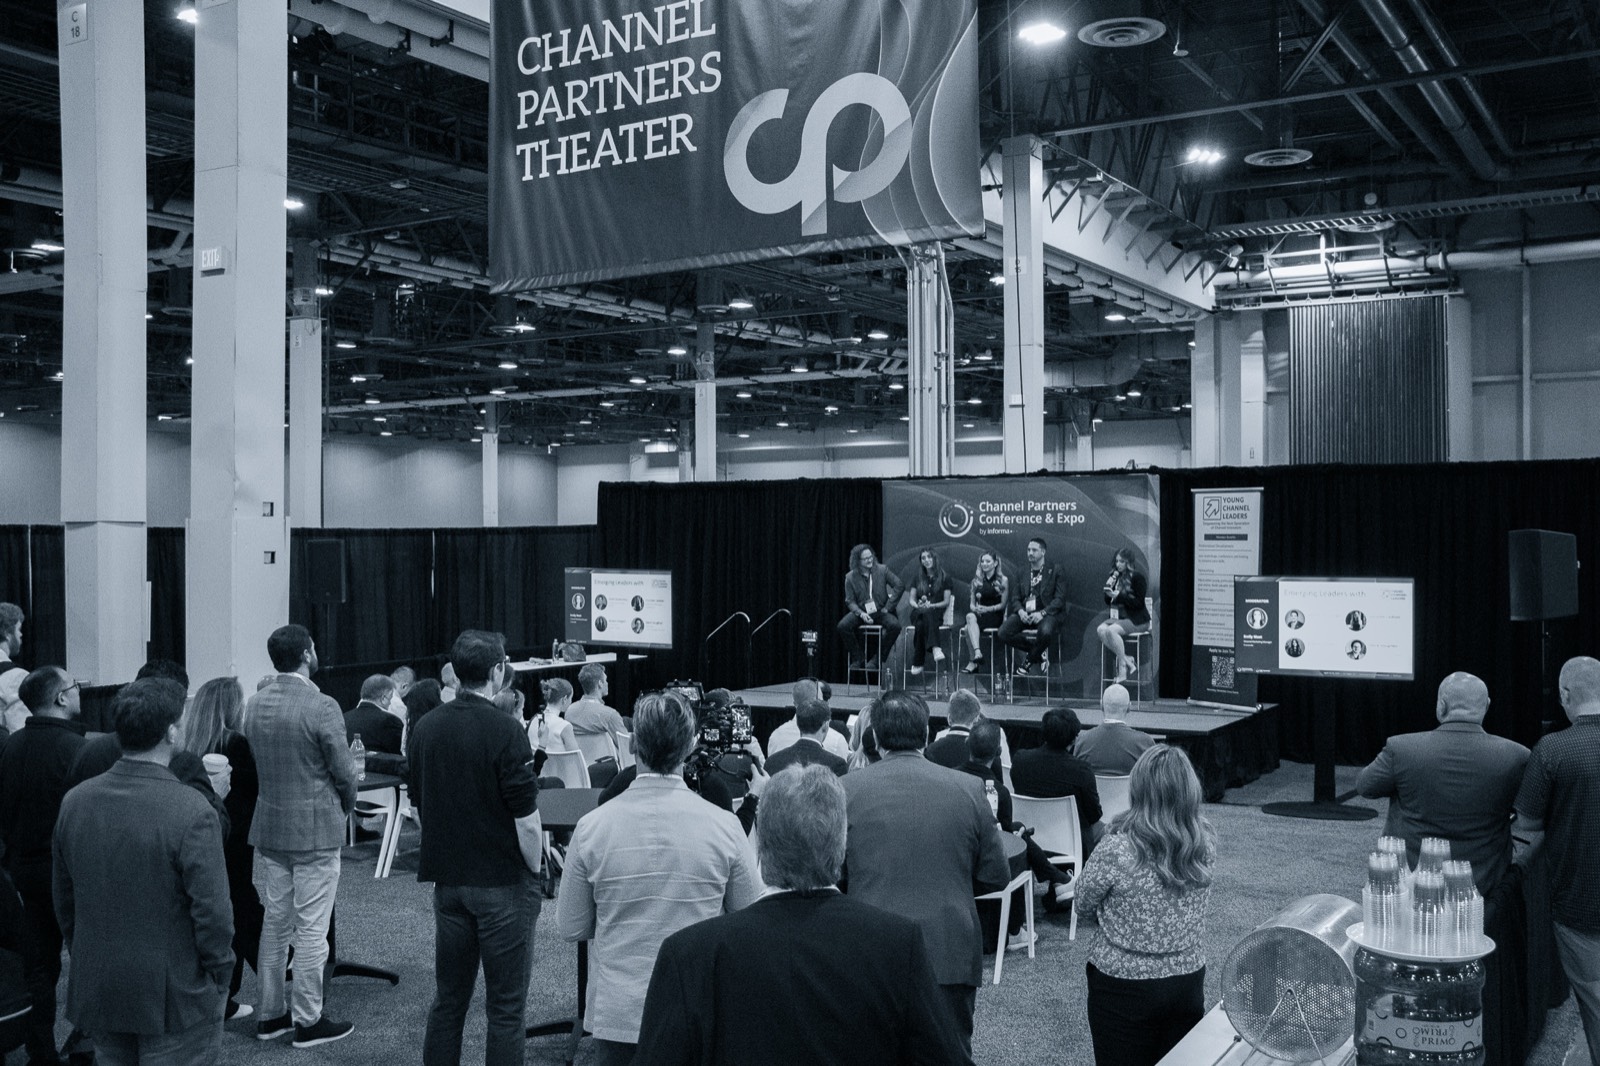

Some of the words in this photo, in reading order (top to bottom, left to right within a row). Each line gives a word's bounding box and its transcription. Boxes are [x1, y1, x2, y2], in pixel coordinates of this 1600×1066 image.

[71, 10, 79, 23] C
[71, 26, 81, 38] 18
[517, 0, 716, 75] CHANNEL
[517, 51, 722, 130] PARTNERS
[516, 113, 698, 181] THEATER
[979, 500, 1025, 512] Channel
[1027, 500, 1077, 511] Partners
[1222, 496, 1245, 504] YOUNG
[979, 513, 1043, 525] Conference
[1045, 513, 1054, 524] &
[1057, 513, 1085, 526] Expo
[1283, 588, 1318, 599] Emerging
[1320, 589, 1347, 598] Leaders
[1349, 590, 1366, 598] with
[1421, 1037, 1456, 1046] PRIMO
